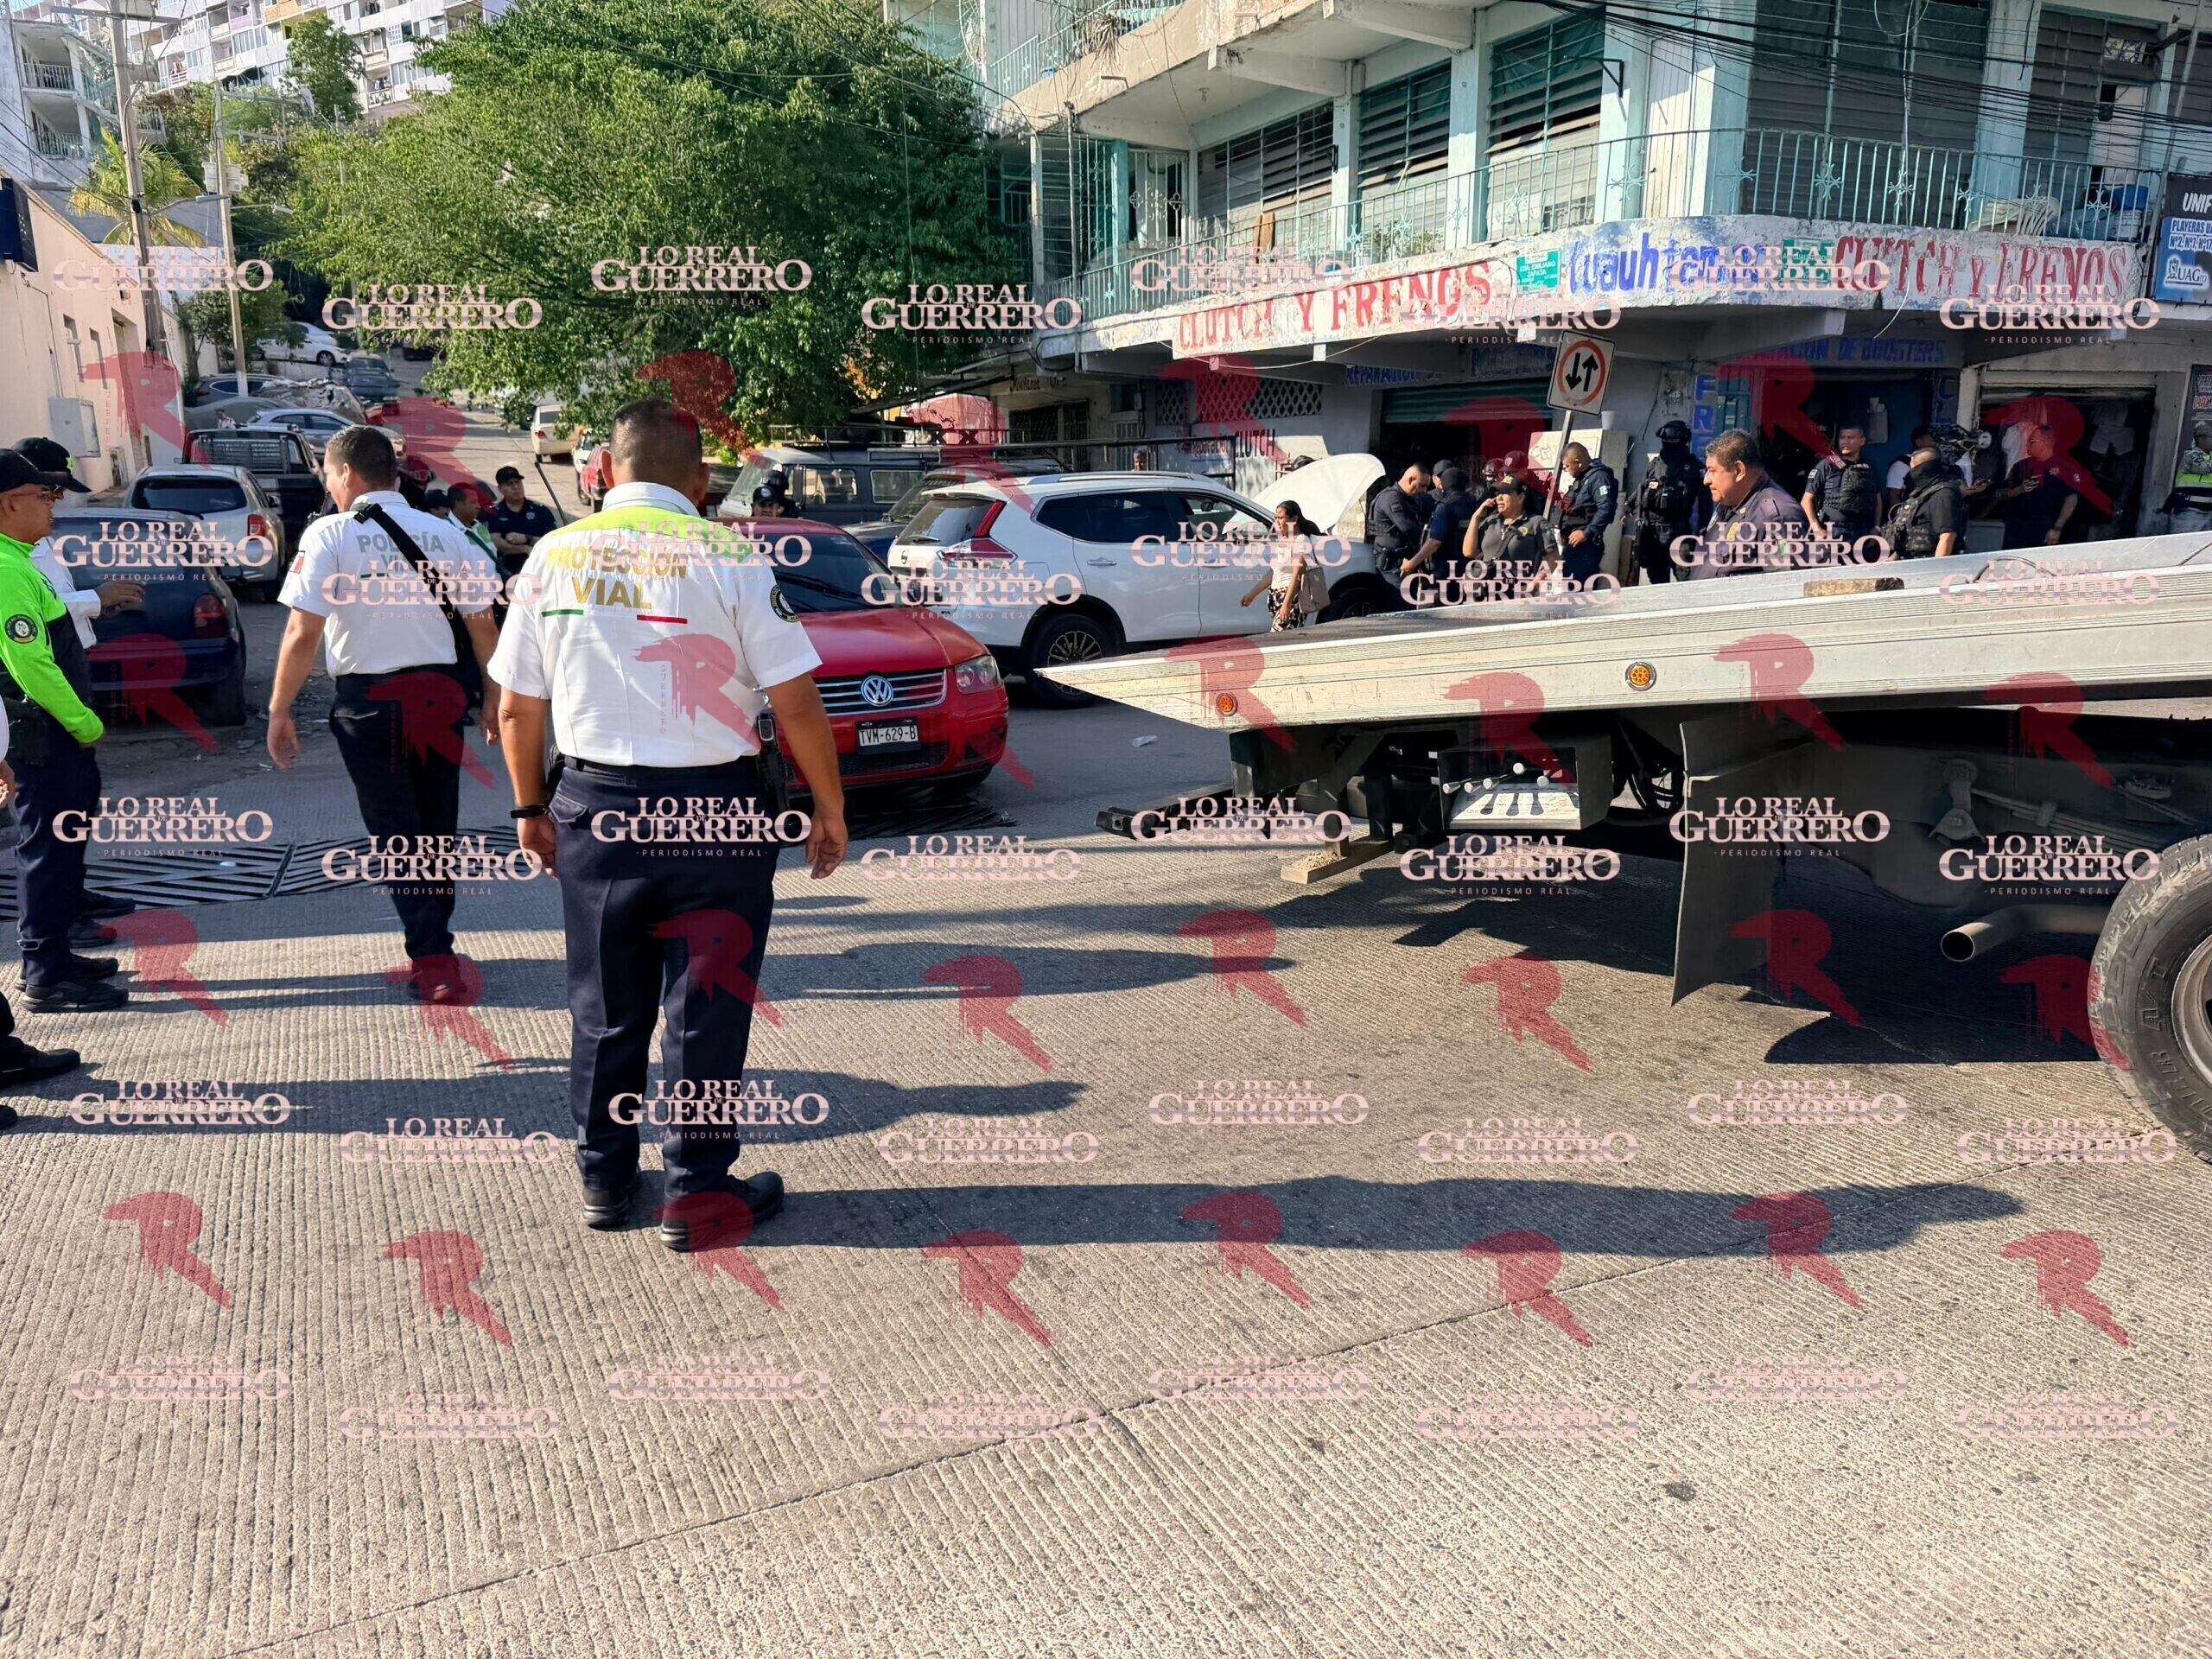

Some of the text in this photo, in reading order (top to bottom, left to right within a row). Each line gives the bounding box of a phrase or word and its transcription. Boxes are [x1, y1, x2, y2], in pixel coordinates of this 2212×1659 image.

[2171, 219, 2205, 234] PLAYERAS
[1527, 269, 1547, 277] ZAPATA
[1294, 291, 1314, 332] Y
[572, 575, 652, 610] VIAL
[860, 726, 916, 745] TVM-629-B
